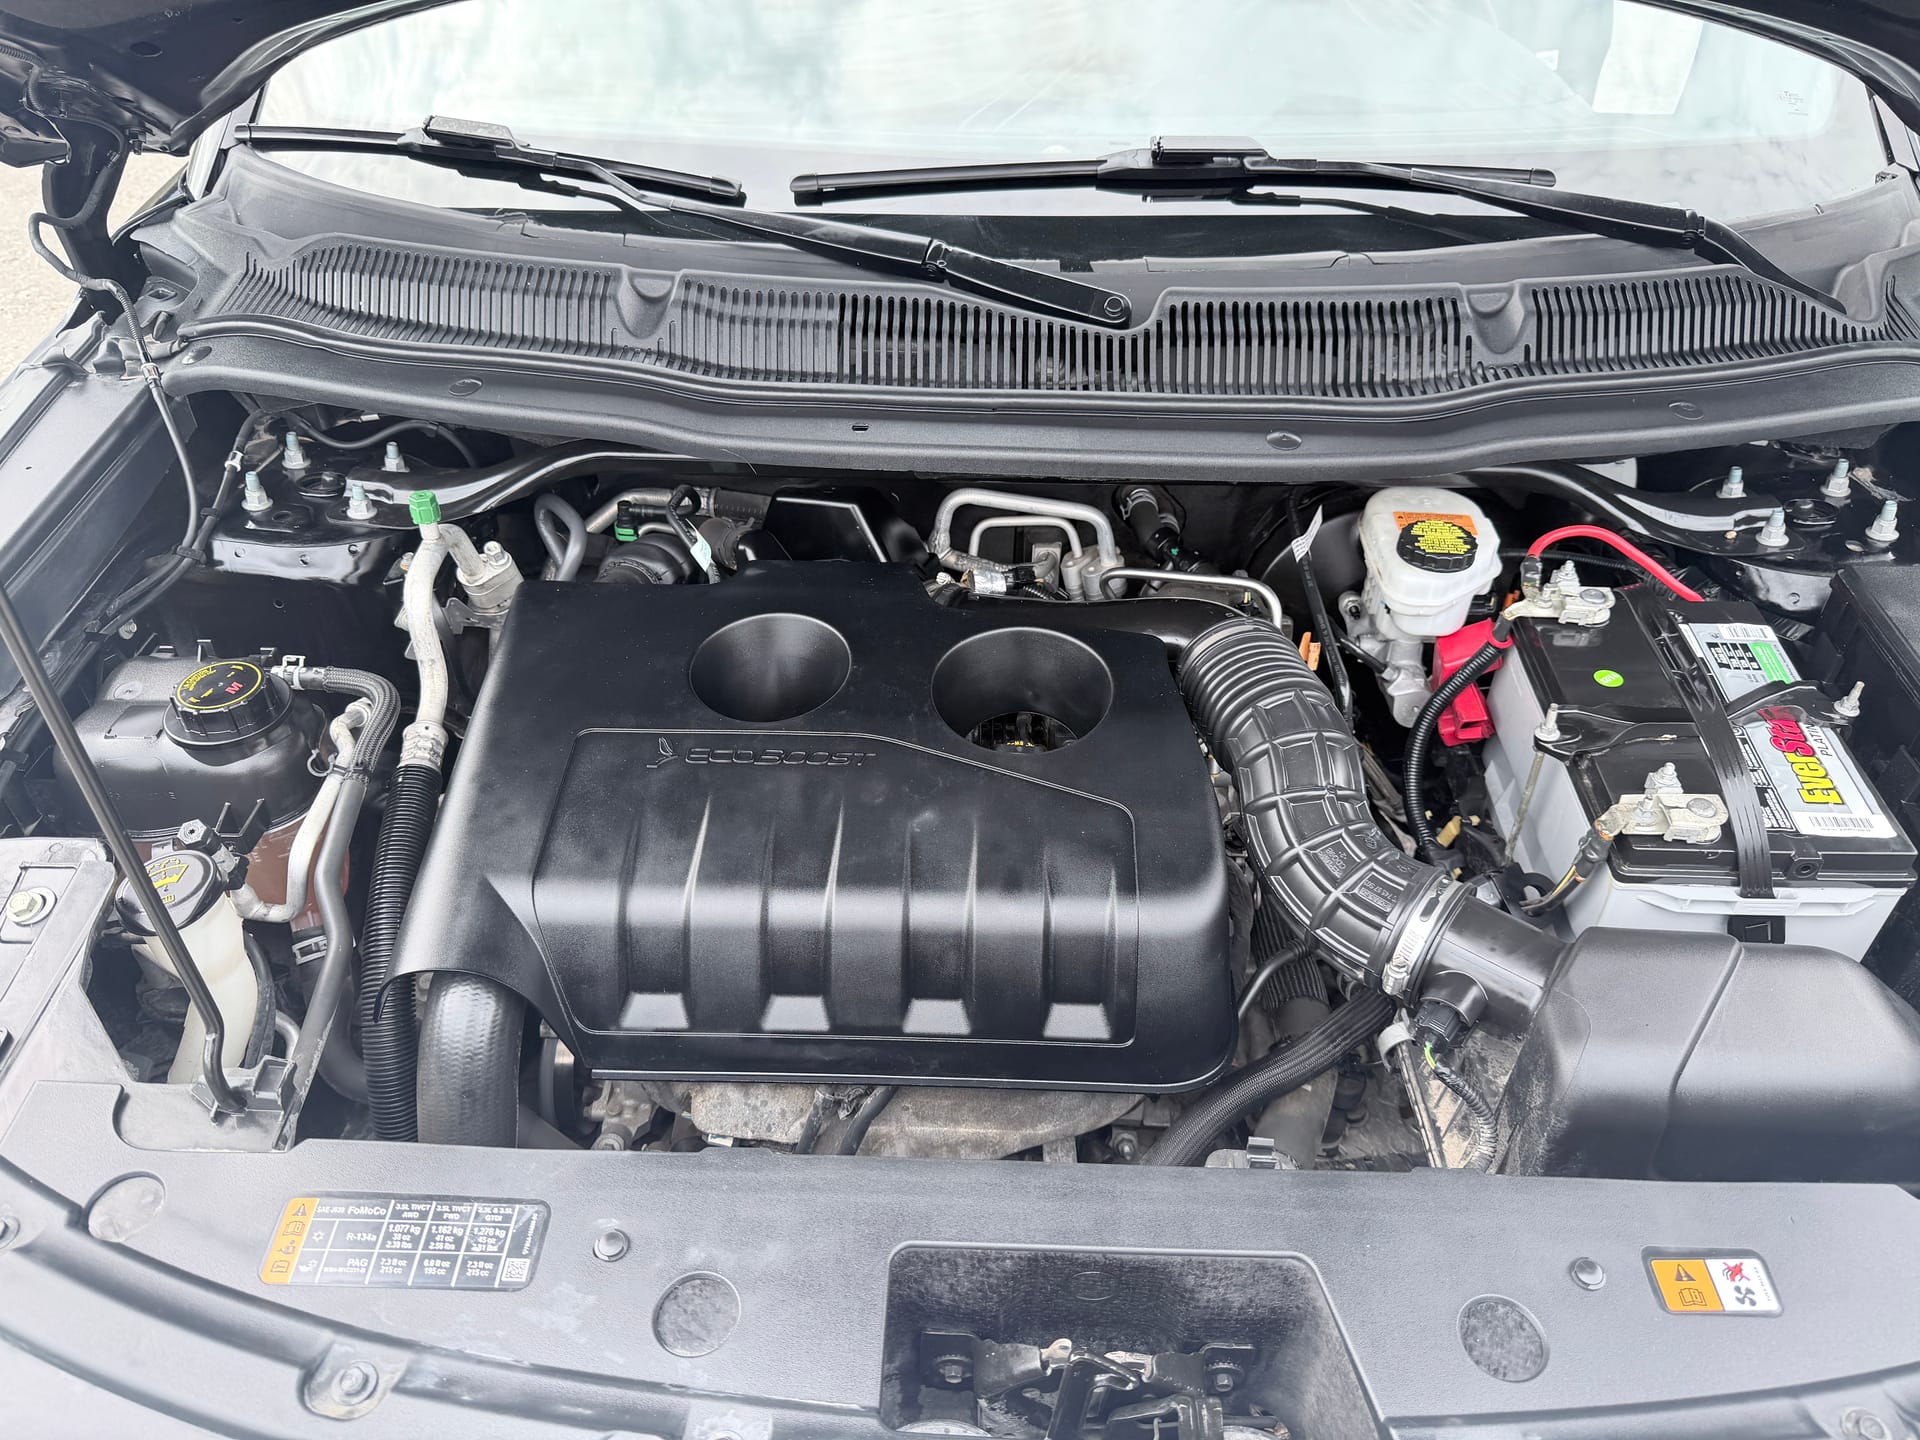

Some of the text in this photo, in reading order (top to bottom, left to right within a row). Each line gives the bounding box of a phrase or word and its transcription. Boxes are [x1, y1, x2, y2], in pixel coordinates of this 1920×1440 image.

[1765, 718, 1845, 805] EverSta
[347, 1205, 387, 1216] FoMoCo
[389, 1223, 422, 1236] 1.077 kg
[453, 1225, 464, 1236] kg
[495, 1227, 507, 1239] kg
[346, 1232, 377, 1242] R-134a
[346, 1258, 369, 1267] PAG
